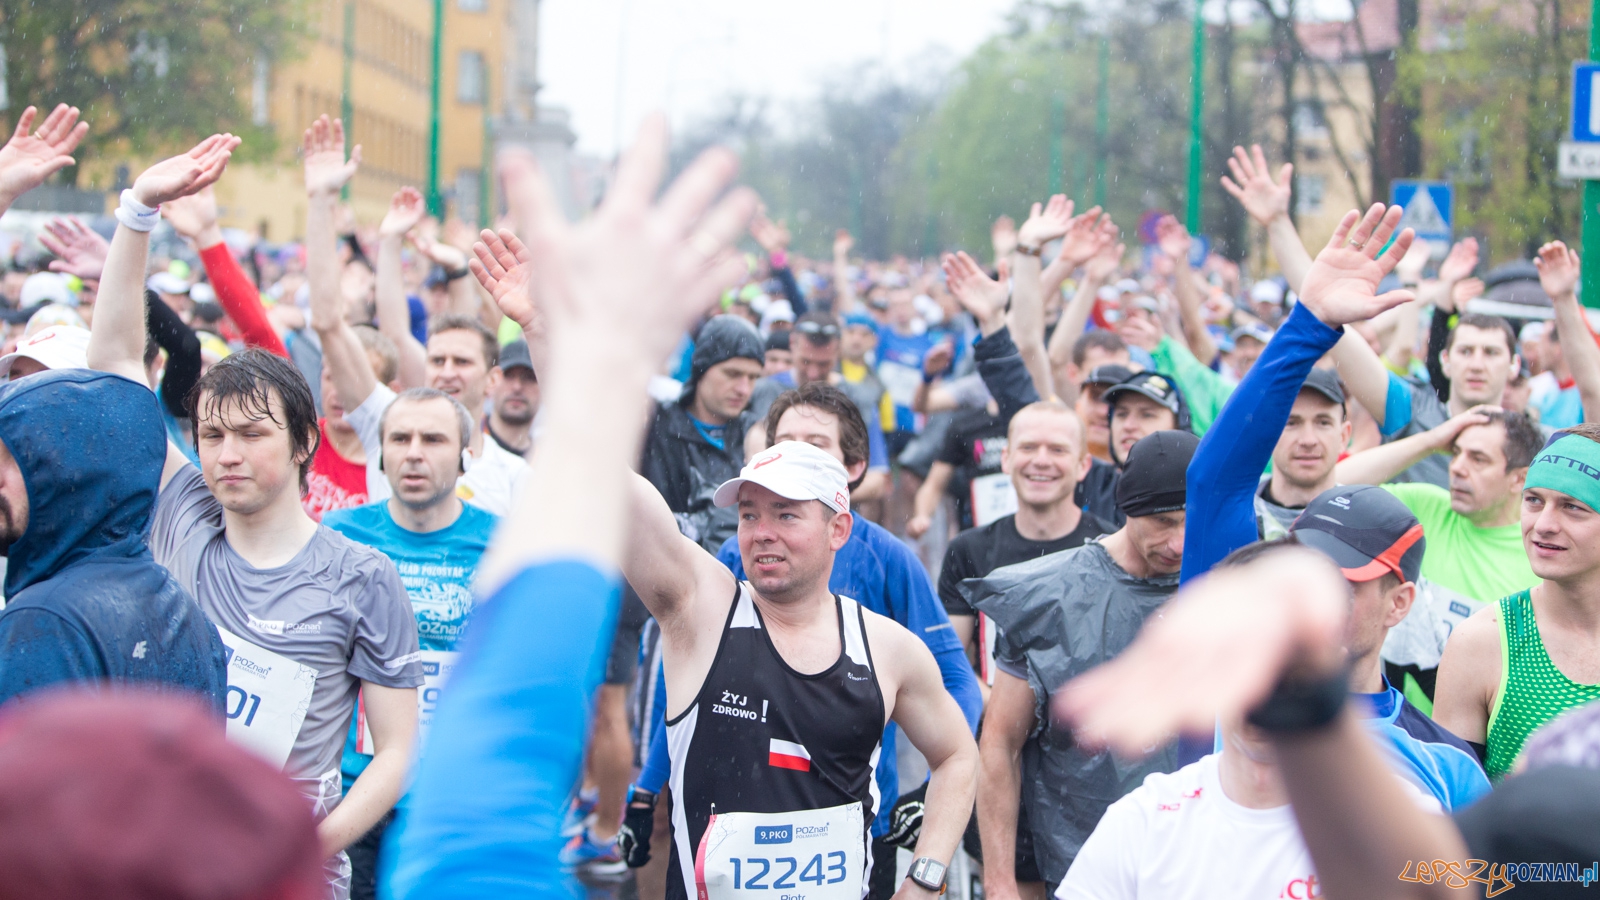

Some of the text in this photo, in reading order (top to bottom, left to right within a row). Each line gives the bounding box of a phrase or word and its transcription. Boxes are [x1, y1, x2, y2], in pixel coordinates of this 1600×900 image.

[721, 689, 748, 706] ŻYJ
[712, 703, 758, 720] ZDROWO
[760, 830, 768, 840] 9.
[769, 830, 788, 839] PKO
[729, 850, 847, 890] 12243
